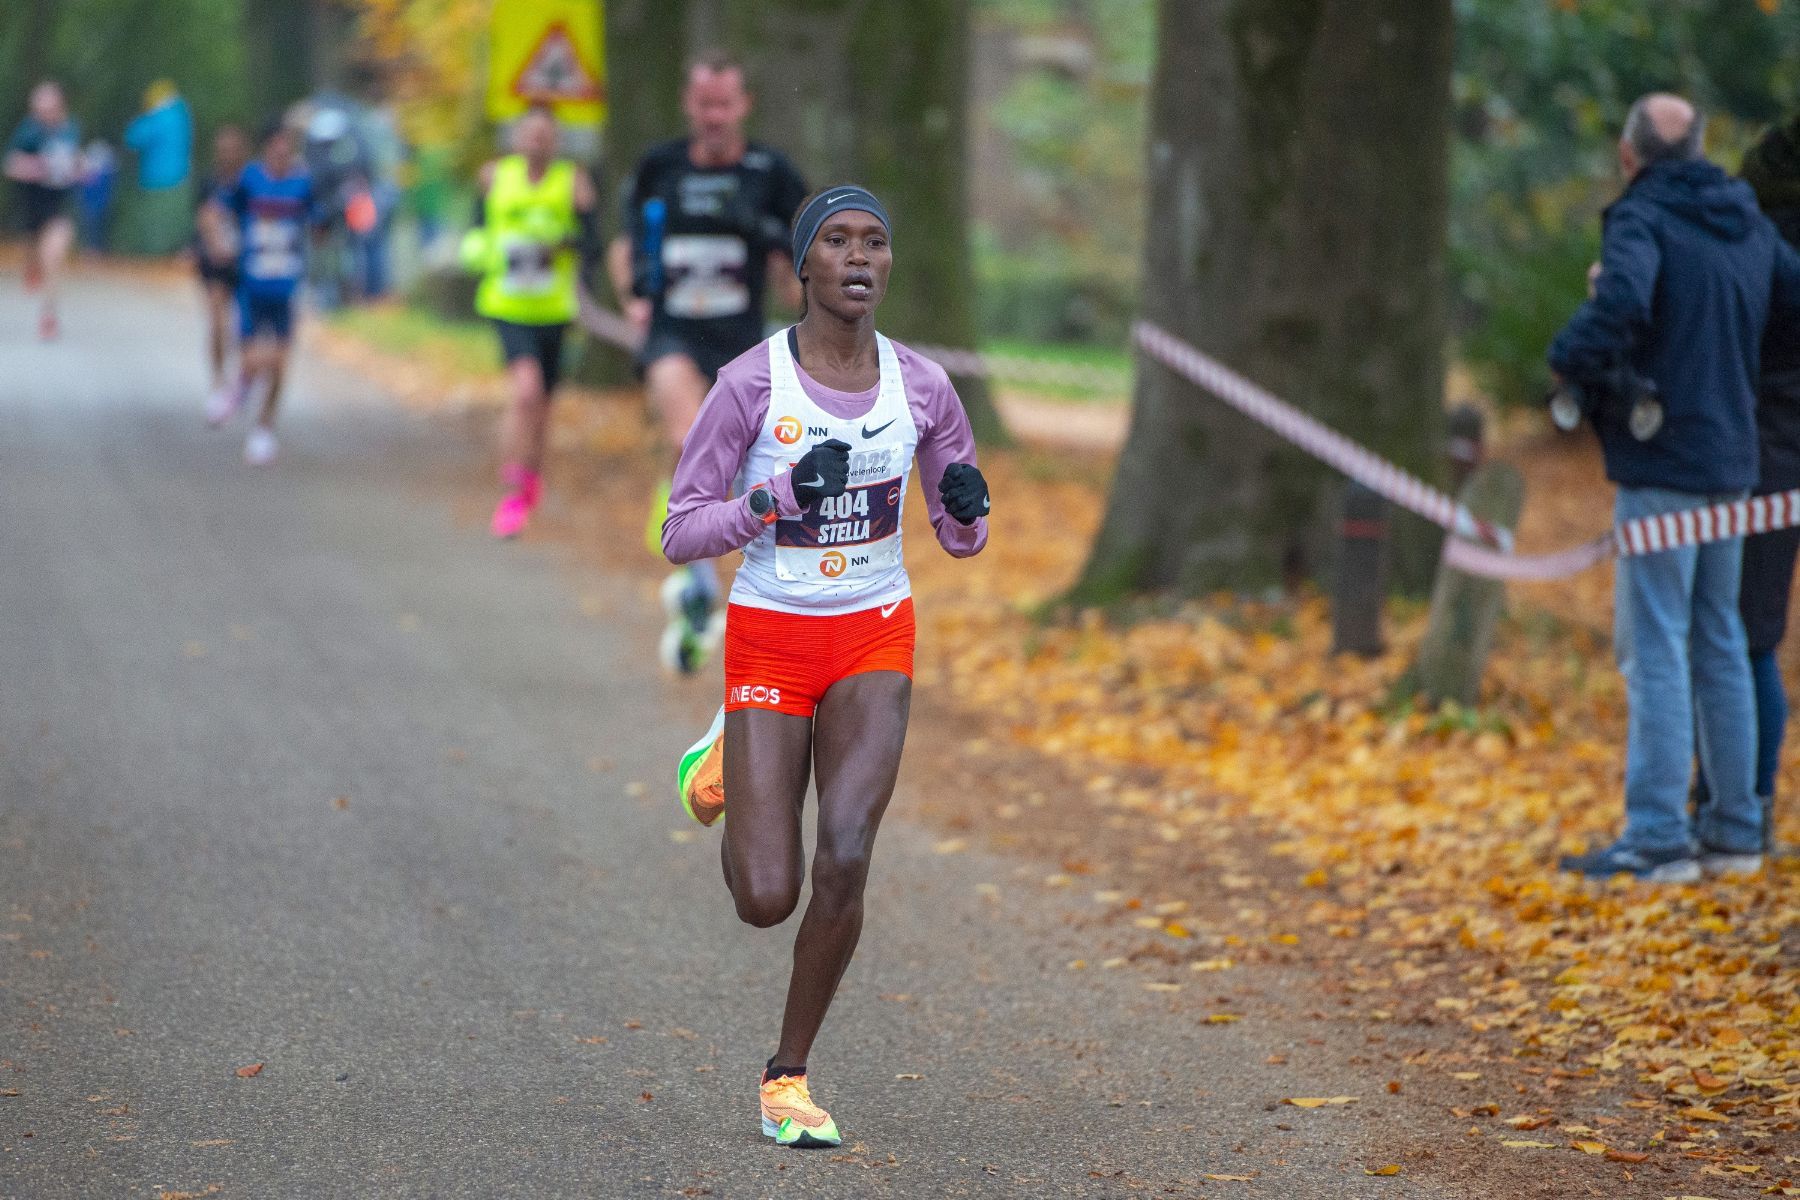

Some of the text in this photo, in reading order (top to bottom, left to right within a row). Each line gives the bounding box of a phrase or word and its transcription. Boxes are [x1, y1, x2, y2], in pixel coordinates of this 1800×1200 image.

[808, 426, 828, 437] NN
[847, 465, 887, 477] velenloop
[848, 449, 892, 484] 022
[819, 489, 869, 520] 404
[817, 519, 870, 544] STELLA
[851, 555, 869, 567] NN
